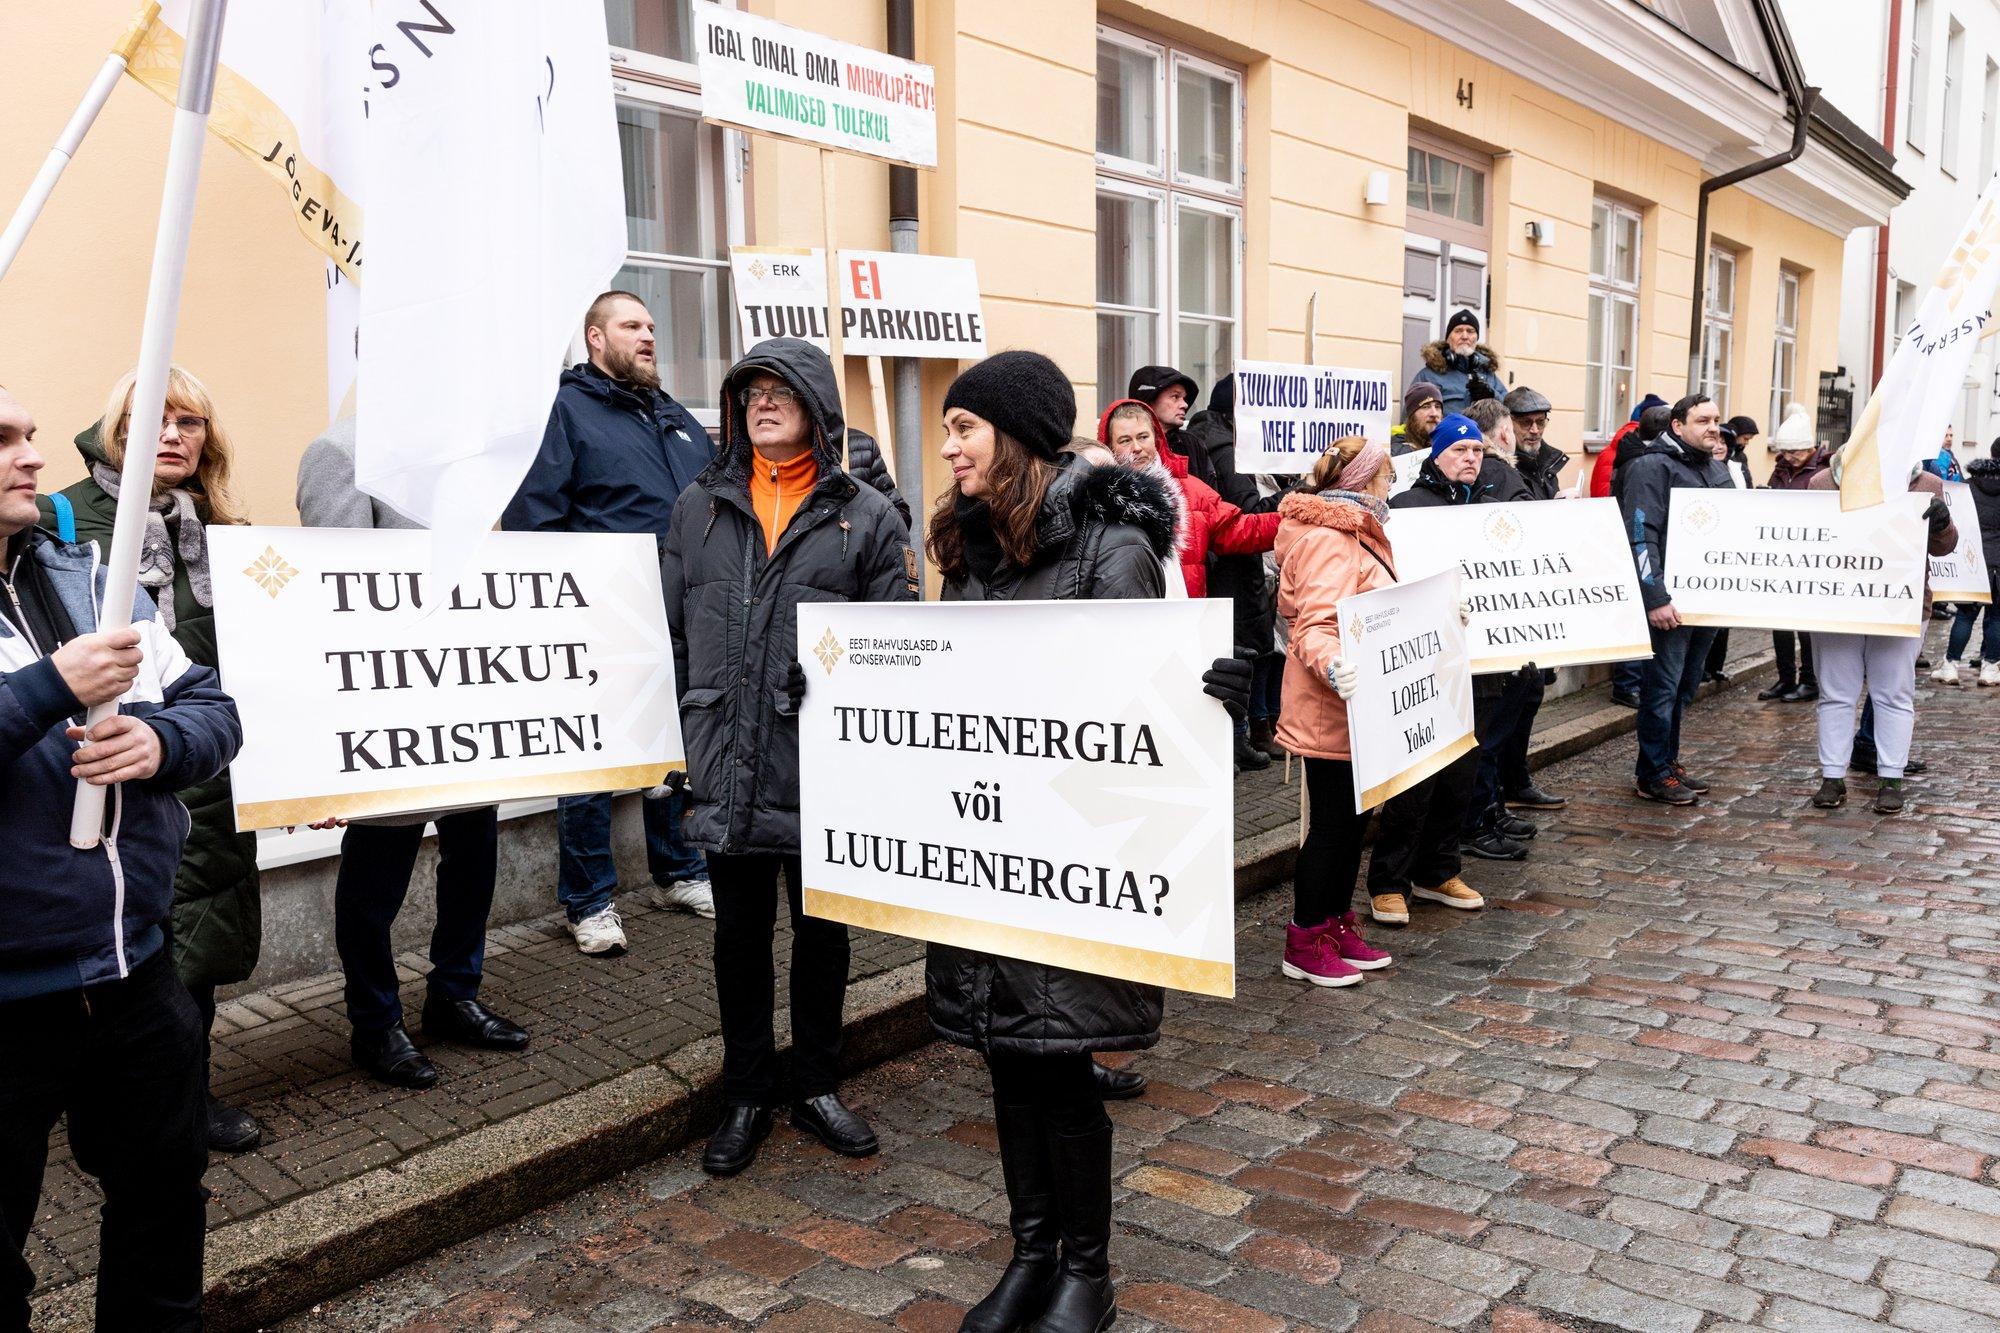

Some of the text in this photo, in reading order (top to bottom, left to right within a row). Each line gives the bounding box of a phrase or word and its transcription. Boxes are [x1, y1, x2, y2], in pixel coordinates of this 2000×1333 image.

[708, 23, 934, 111] IGAL OINAL OMA MIHKLIPÄEV!
[745, 80, 891, 143] VALIMISED TULEKUL
[1456, 78, 1473, 109] 41
[772, 264, 800, 277] ERK
[850, 259, 882, 300] EI
[1238, 371, 1387, 412] TUULIKUD HÄVITAVAD
[1261, 420, 1296, 453] MEIE
[1755, 525, 1838, 542] TUULE-
[1532, 552, 1573, 576] JÄÄ
[1704, 550, 1883, 571] GENERAATORID
[1673, 575, 1914, 600] LOODUSKAITSE ALLA
[849, 638, 952, 652] EESTI RAHVUSLASED JA
[1380, 629, 1442, 675] LENNUTA
[1486, 622, 1566, 645] KINNI!!
[325, 642, 599, 692] TIIVIKUT,
[849, 653, 921, 667] KONSERVATIIVID
[1391, 673, 1440, 716] LOHET,
[336, 713, 602, 773] KRISTEN!
[833, 706, 1164, 767] TUULEENERGIA
[1403, 717, 1436, 754] Yoko!
[951, 780, 1003, 823] või
[824, 828, 1170, 917] LUULEENERGIA?
